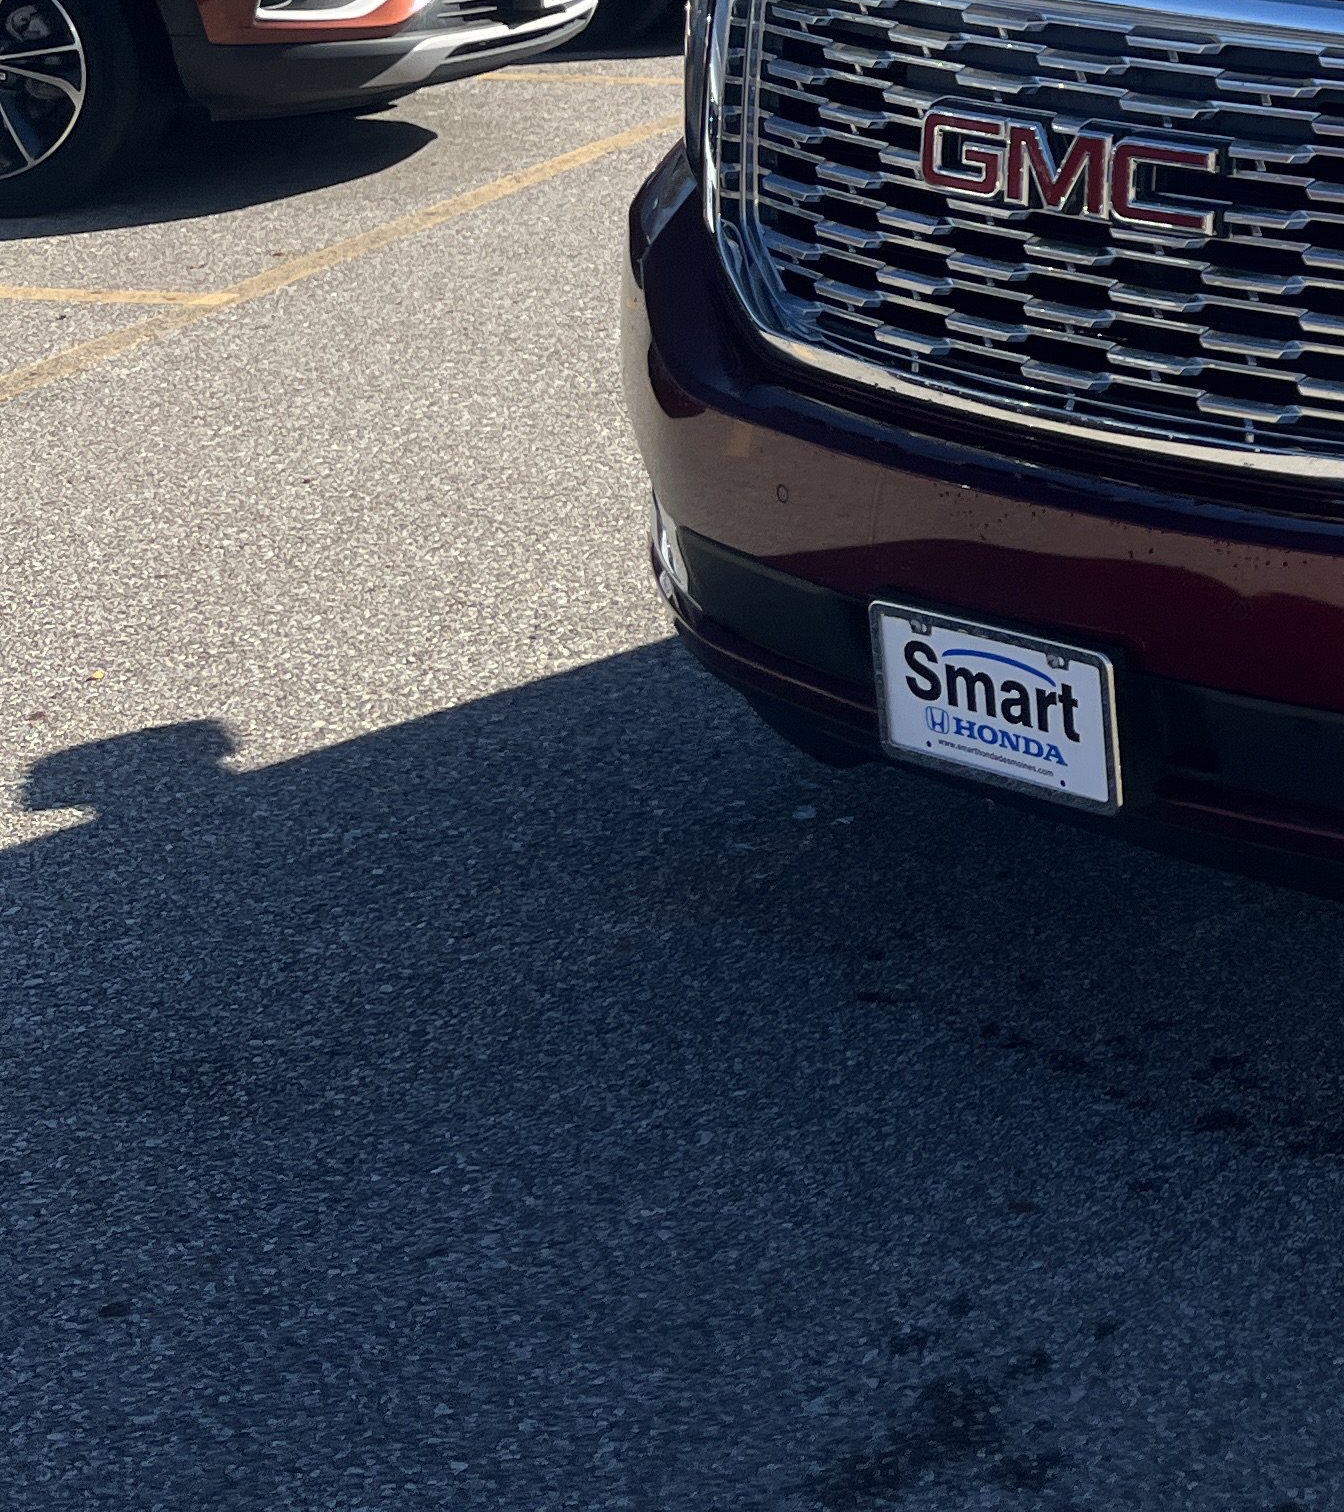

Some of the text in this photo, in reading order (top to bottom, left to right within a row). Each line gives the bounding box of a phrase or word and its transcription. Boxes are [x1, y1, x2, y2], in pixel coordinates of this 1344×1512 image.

[921, 108, 1219, 235] GMC
[904, 640, 1081, 743] Smart
[952, 716, 1068, 766] HONDA
